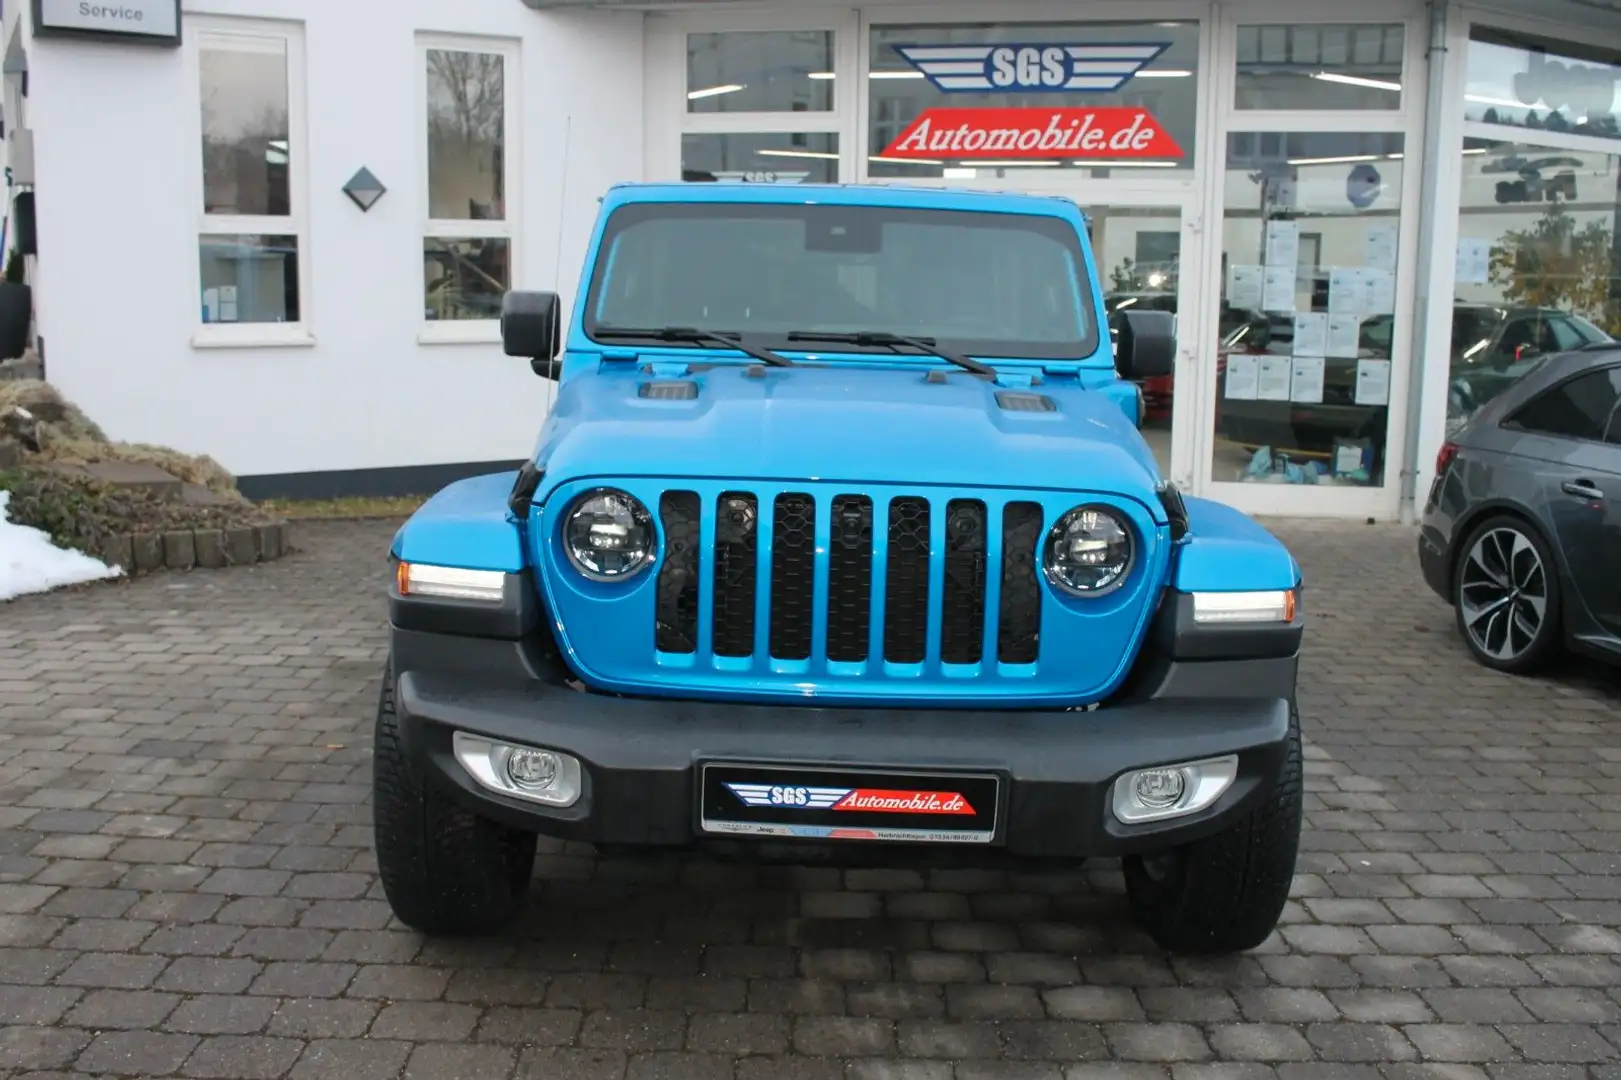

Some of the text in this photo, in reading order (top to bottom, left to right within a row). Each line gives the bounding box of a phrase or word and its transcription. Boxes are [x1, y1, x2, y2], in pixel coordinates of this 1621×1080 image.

[79, 2, 143, 21] Service
[992, 47, 1065, 86] SGS
[896, 114, 1155, 151] Automobile.de
[771, 786, 964, 812] SGS Automobile.de
